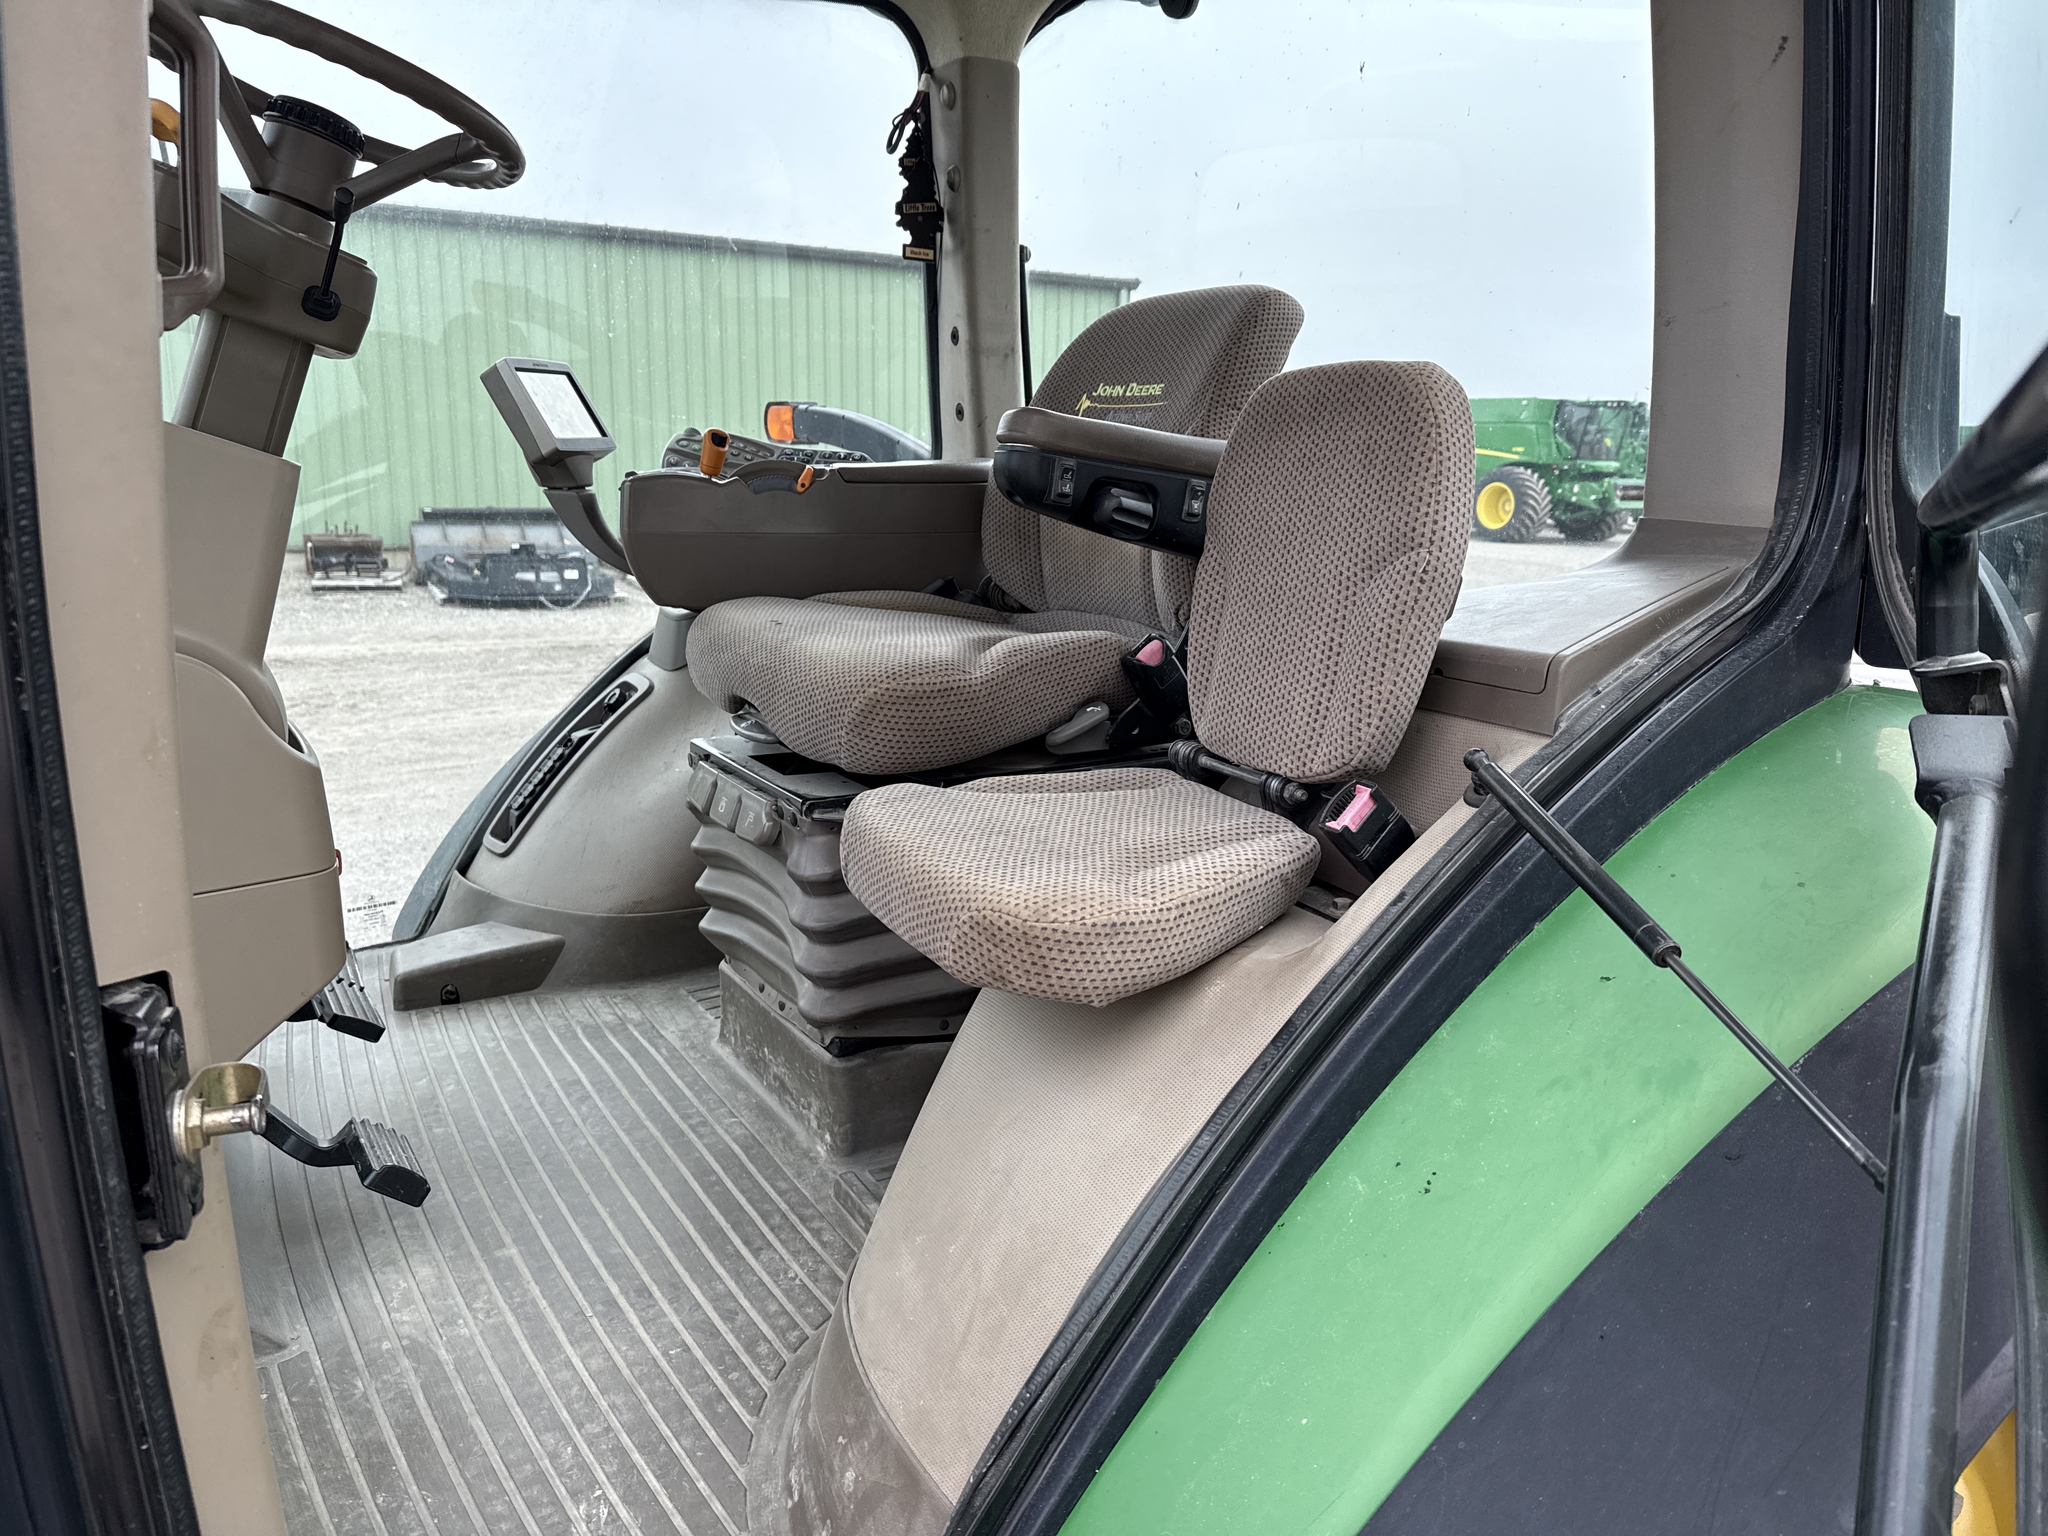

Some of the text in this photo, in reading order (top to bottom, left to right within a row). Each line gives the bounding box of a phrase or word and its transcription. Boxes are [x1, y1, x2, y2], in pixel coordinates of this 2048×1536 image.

[905, 203, 935, 212] Little Trees
[1092, 382, 1165, 396] JOHN DEERE
